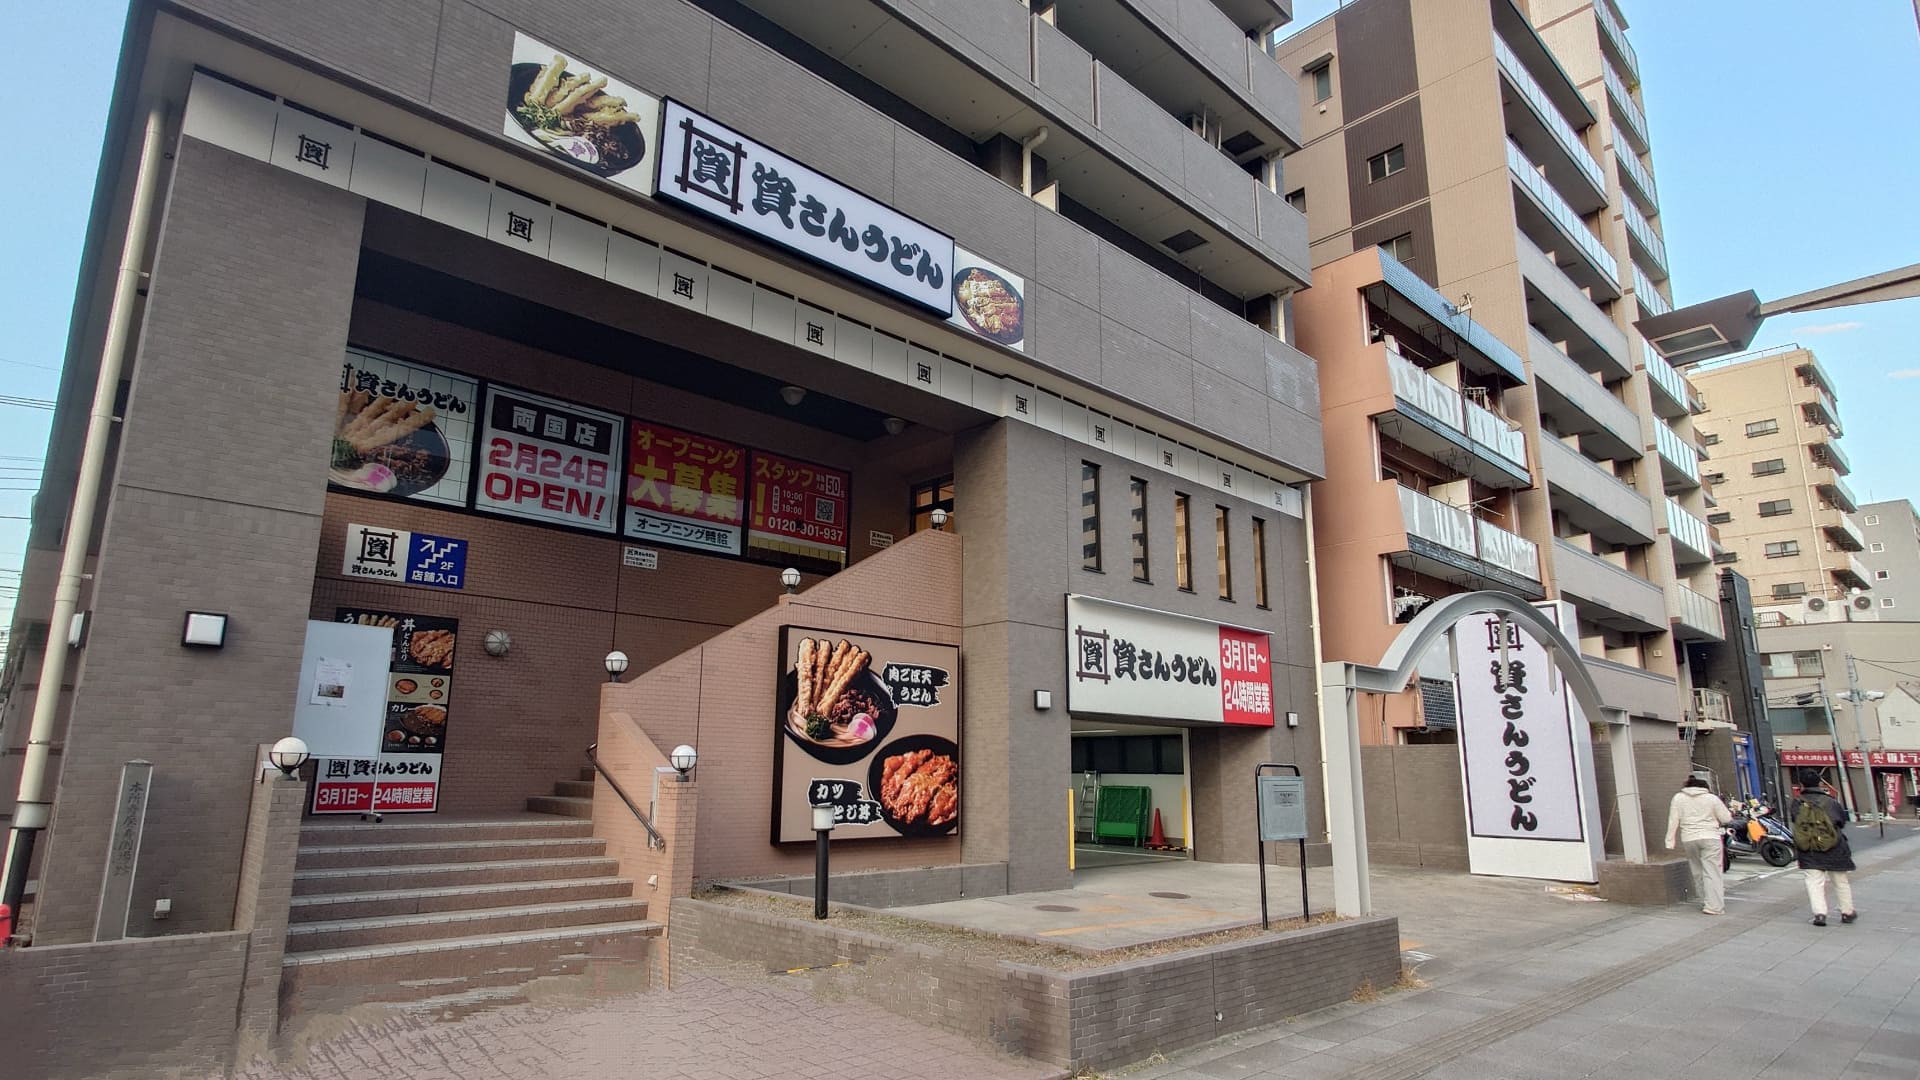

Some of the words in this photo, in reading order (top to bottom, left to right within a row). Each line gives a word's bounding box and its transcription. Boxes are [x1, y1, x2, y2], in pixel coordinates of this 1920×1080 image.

[752, 162, 943, 290] 資さんうどん
[355, 369, 467, 414] 資さんうどん
[512, 405, 599, 447] 両国店
[488, 437, 609, 489] 2月24日
[637, 428, 740, 469] オープニング
[755, 457, 814, 488] スタッフ
[485, 472, 606, 520] OPEN!
[631, 455, 738, 521] 大募集
[827, 476, 839, 494] 50
[637, 516, 728, 546] オープニング時給
[768, 516, 844, 541] 0120-301-937
[351, 564, 398, 578] 資さんうどん
[411, 569, 459, 586] 店舗入口
[440, 561, 455, 571] 2F
[1112, 638, 1217, 687] 資さんうどん
[900, 688, 932, 703] うどん
[1223, 679, 1271, 715] 24時間営業
[1490, 659, 1538, 832] 資さんうどん
[352, 760, 433, 776] 資さんうどん
[374, 787, 434, 805] 24時間営業
[816, 783, 845, 800] カツ
